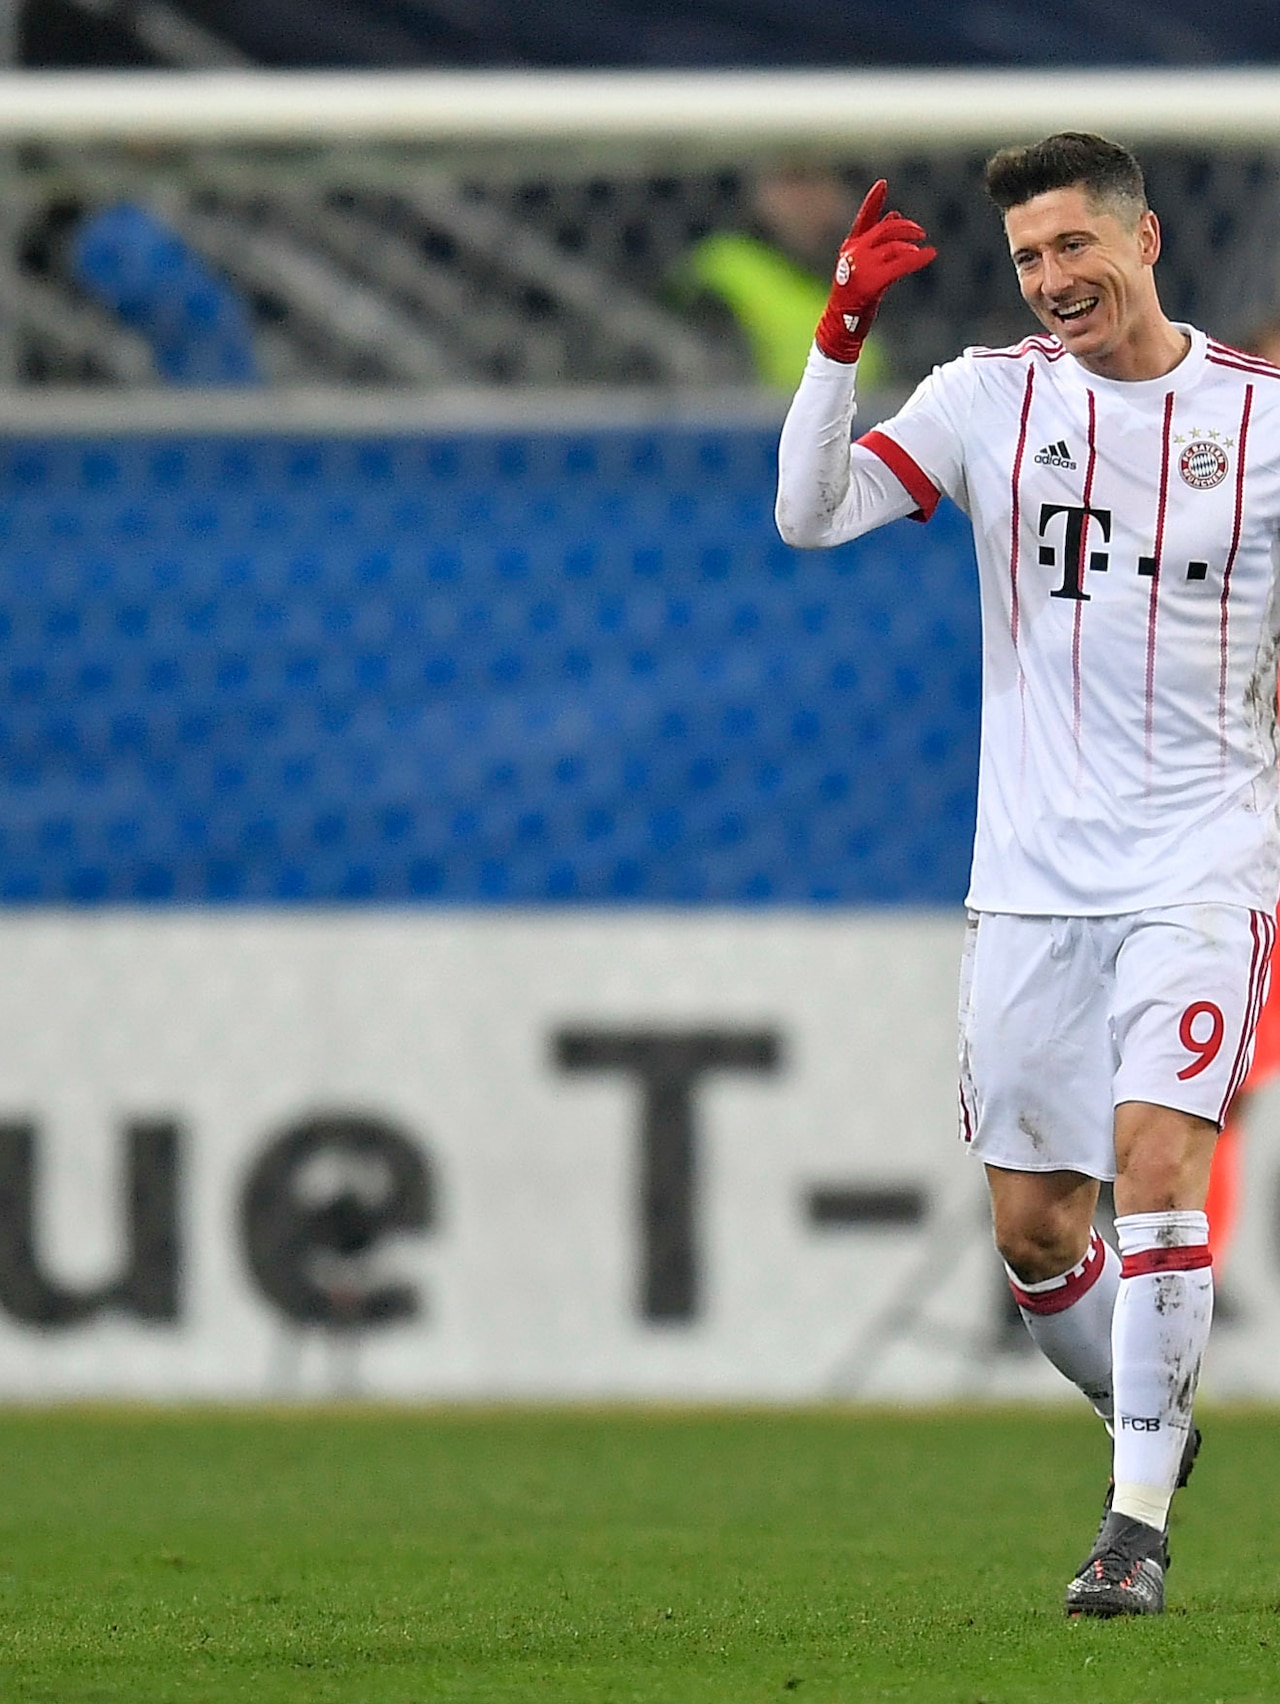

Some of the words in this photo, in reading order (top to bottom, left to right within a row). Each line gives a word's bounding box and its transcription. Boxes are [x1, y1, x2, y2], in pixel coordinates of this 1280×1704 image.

[1034, 454, 1077, 470] adidas
[1192, 443, 1224, 463] BAYERN
[1176, 1000, 1225, 1081] 9
[1121, 1416, 1161, 1432] FCB
